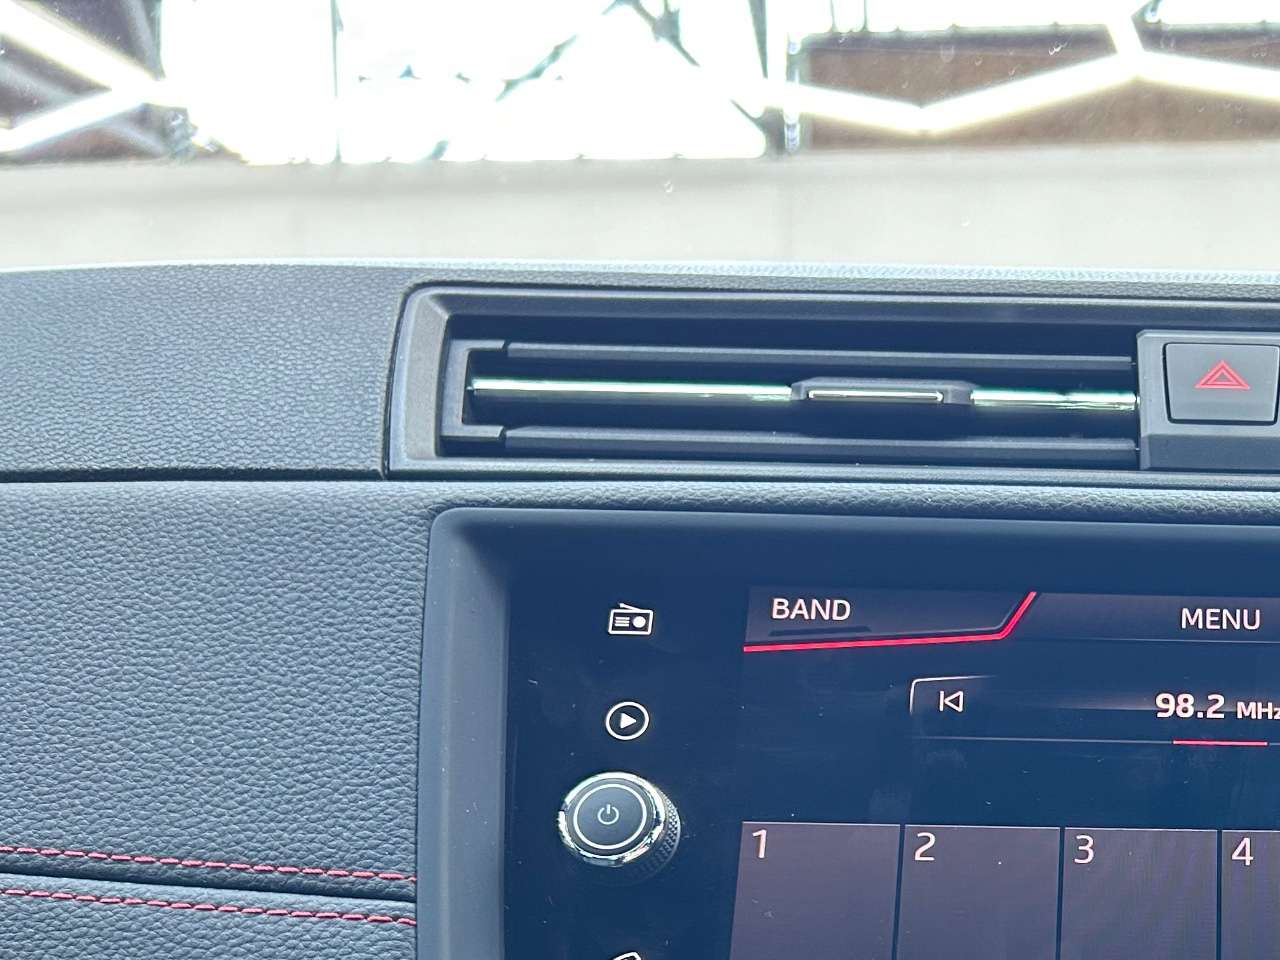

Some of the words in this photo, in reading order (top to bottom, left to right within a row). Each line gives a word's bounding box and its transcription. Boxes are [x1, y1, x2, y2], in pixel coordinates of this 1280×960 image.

[772, 597, 851, 621] BAND
[1181, 607, 1261, 630] MENU
[1155, 692, 1225, 719] 98.2
[752, 829, 767, 859] 1
[912, 832, 936, 862] 2
[1072, 835, 1097, 864] 3
[1231, 837, 1254, 866] 4
